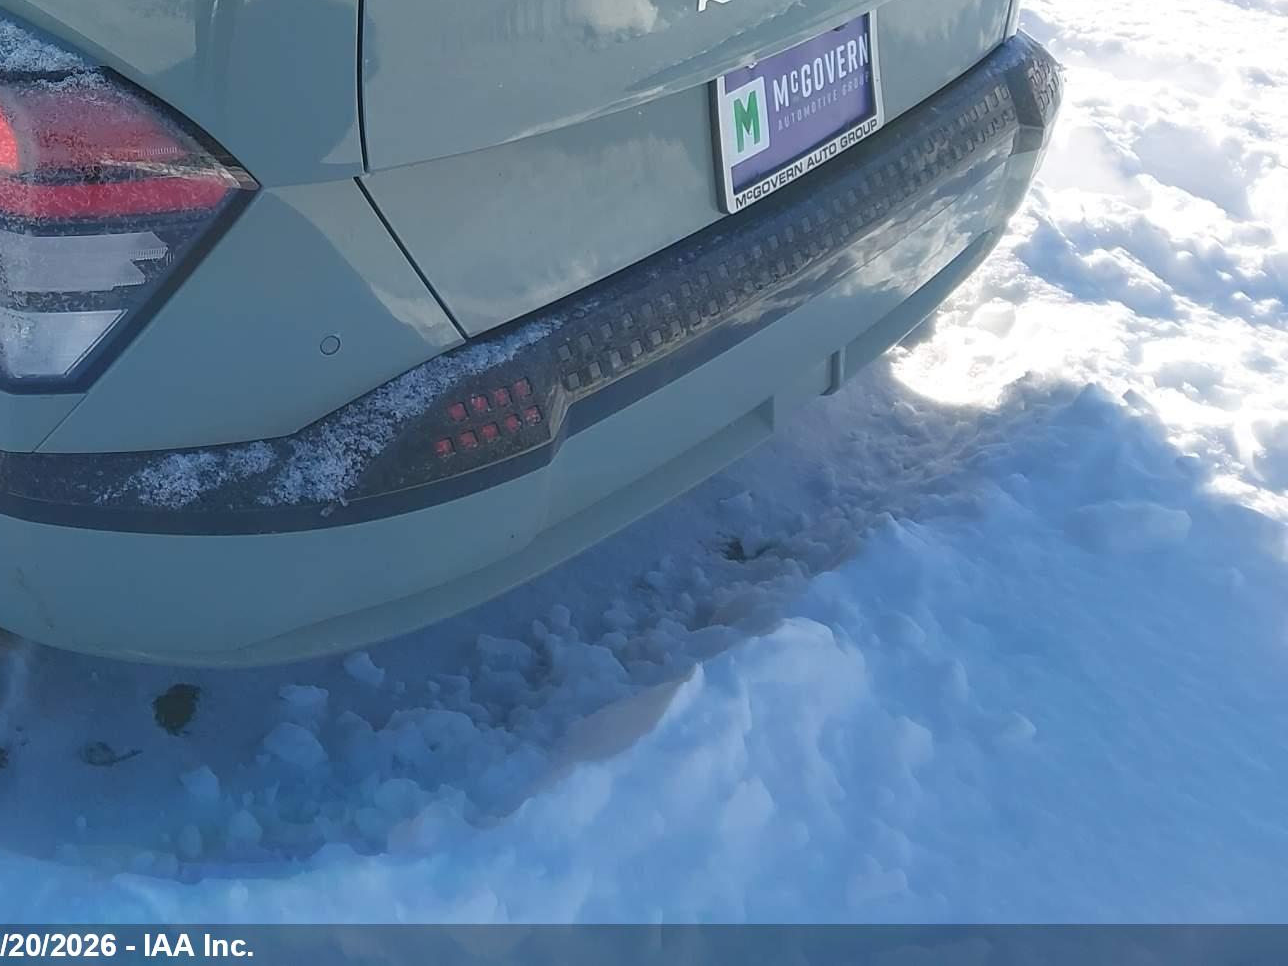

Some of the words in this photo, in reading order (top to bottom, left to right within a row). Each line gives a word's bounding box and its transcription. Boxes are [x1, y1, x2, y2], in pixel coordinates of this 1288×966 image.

[732, 89, 761, 154] M
[778, 89, 838, 131] AUTOMOTIVE
[806, 143, 838, 171] AUTO
[839, 118, 878, 148] GROUP
